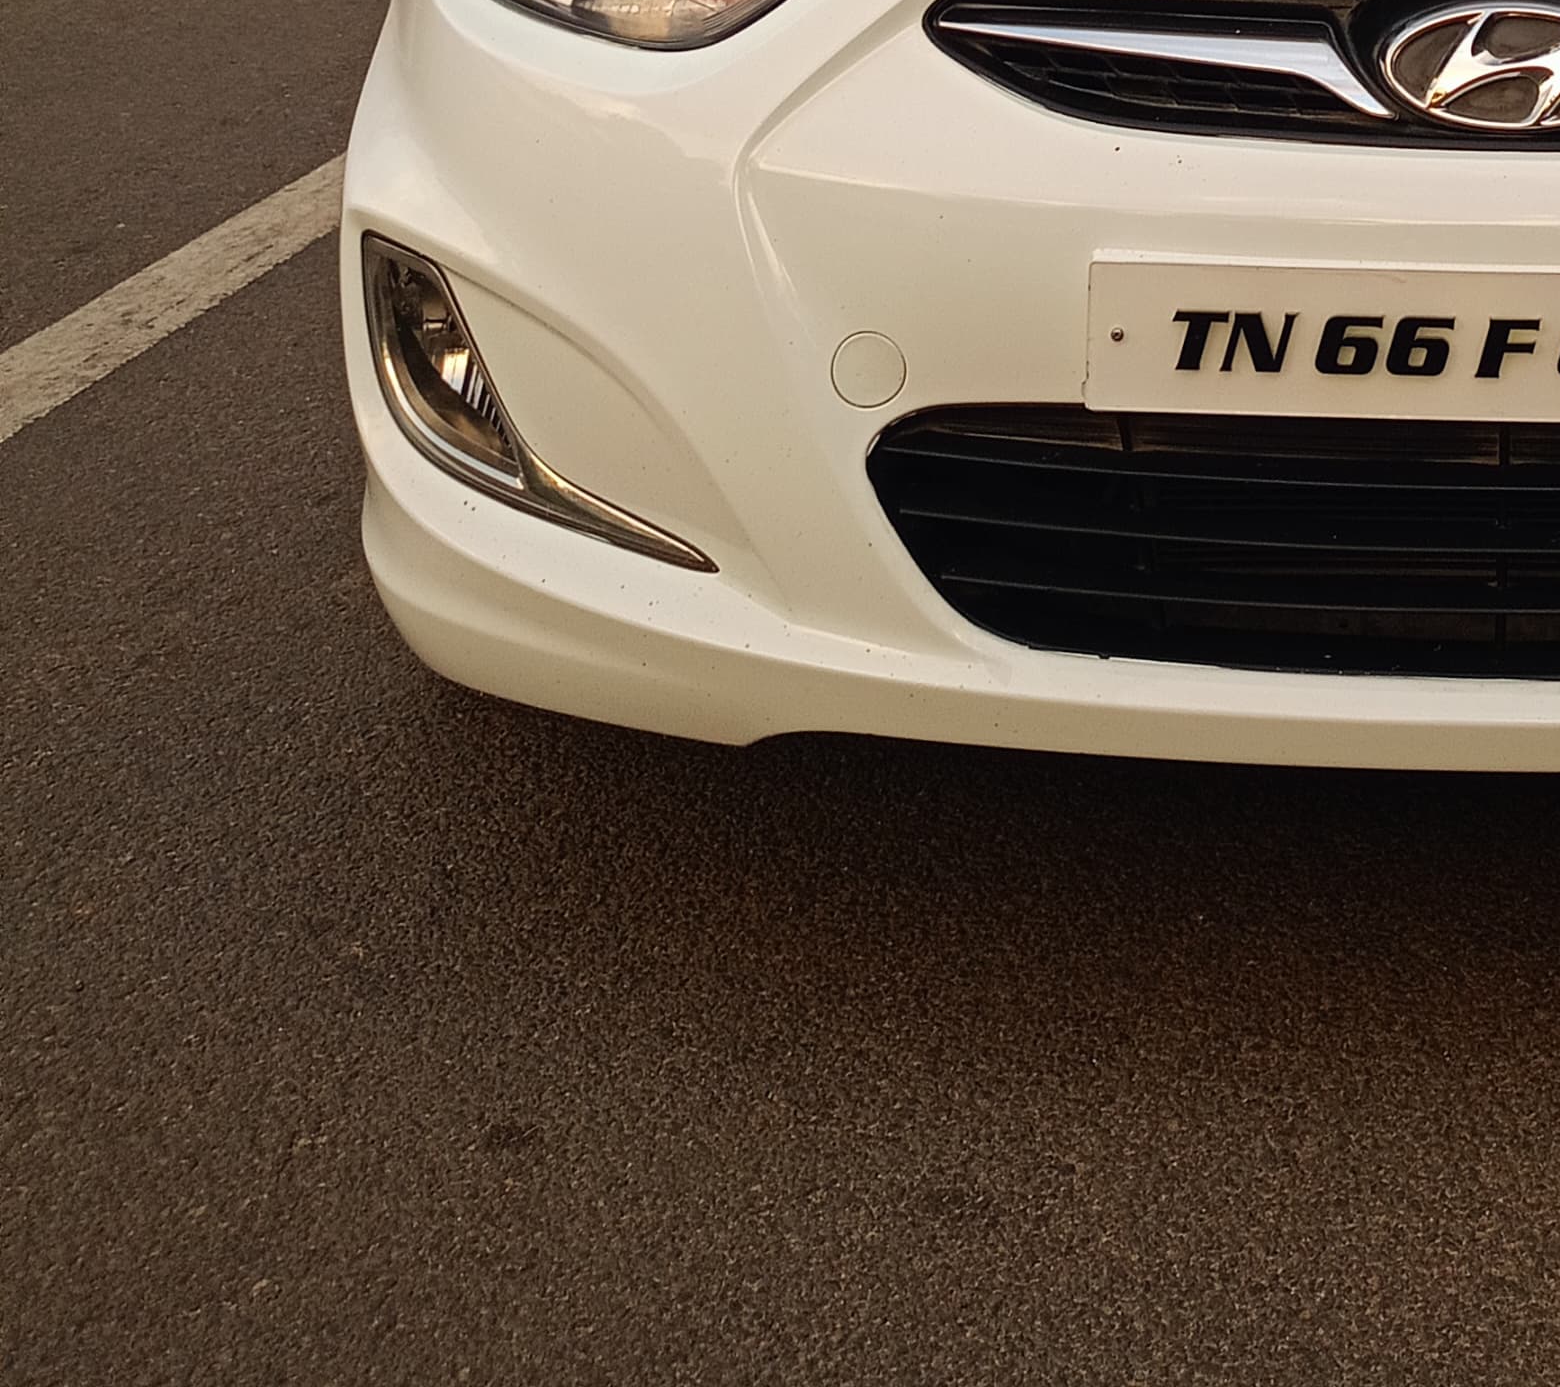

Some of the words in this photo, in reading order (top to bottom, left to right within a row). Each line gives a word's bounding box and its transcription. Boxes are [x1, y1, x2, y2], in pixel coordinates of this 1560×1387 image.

[1172, 310, 1299, 373] TN
[1314, 315, 1456, 377] 66
[1474, 318, 1542, 379] F
